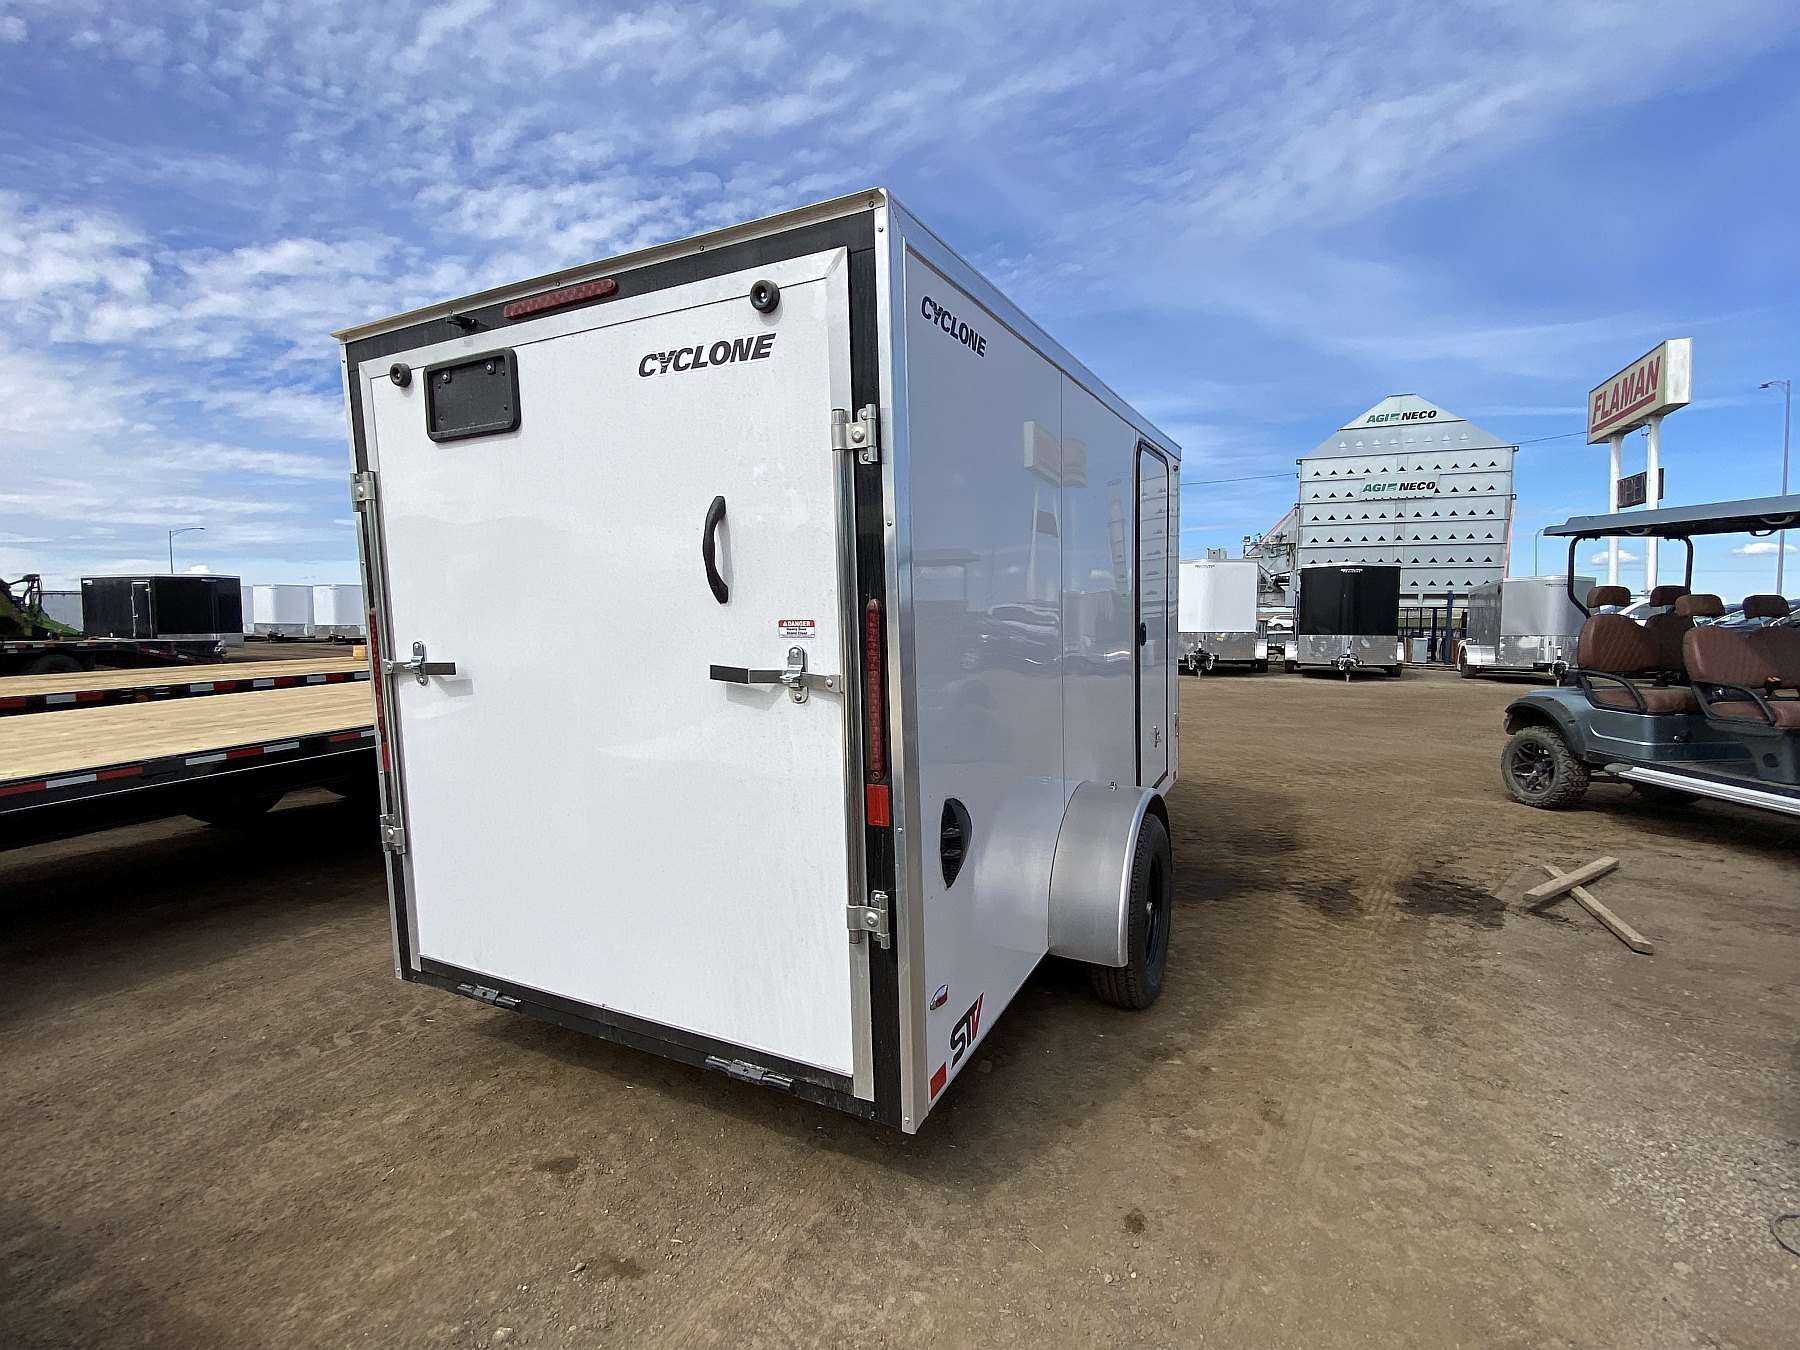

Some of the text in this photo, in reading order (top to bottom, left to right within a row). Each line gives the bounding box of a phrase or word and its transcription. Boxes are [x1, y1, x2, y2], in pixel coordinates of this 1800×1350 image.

[921, 295, 987, 357] CYCLONE
[638, 332, 777, 378] CYCLONE
[1591, 355, 1661, 425] FLAMAN
[1366, 410, 1437, 423] AGI NECO
[1362, 481, 1436, 492] AGI NECO
